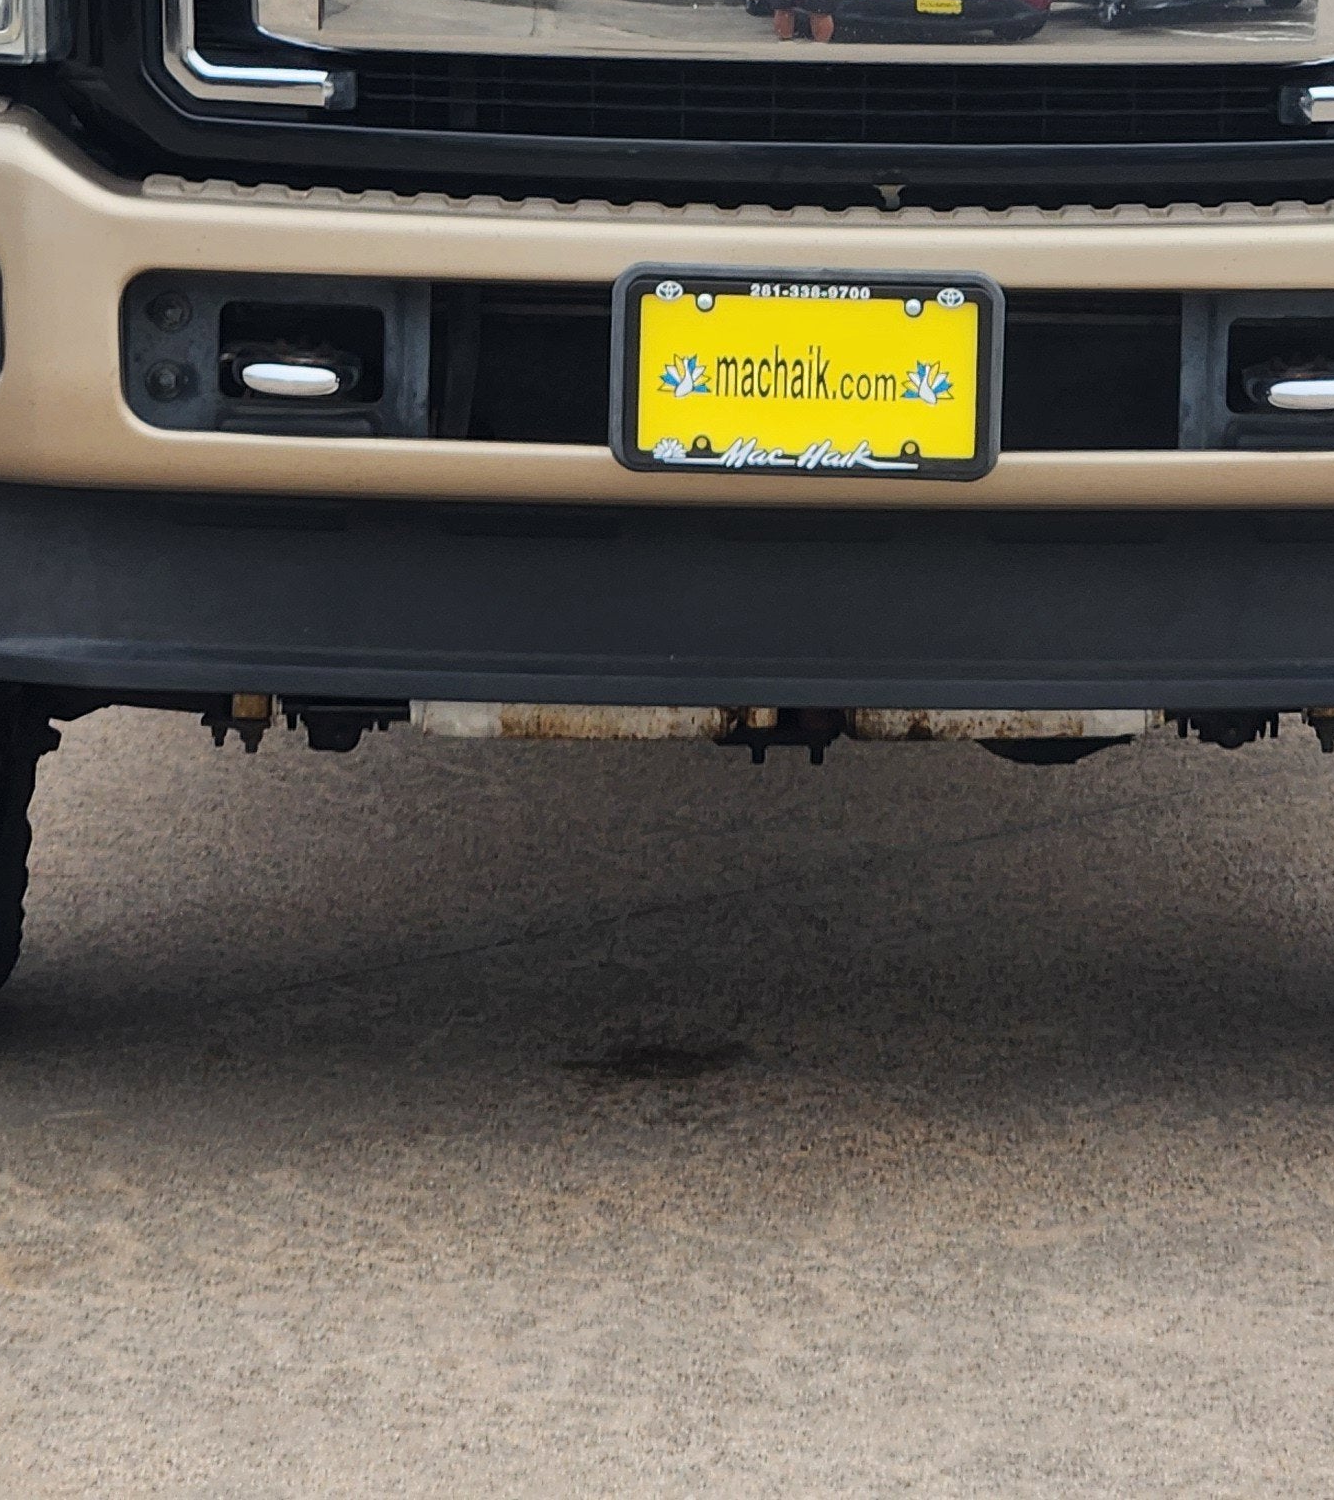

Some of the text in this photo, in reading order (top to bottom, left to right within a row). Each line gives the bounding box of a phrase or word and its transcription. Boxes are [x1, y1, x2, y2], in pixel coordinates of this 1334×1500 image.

[749, 282, 871, 300] 281-338-9700
[714, 344, 897, 402] machaik.com
[719, 437, 878, 470] Mac Haik
